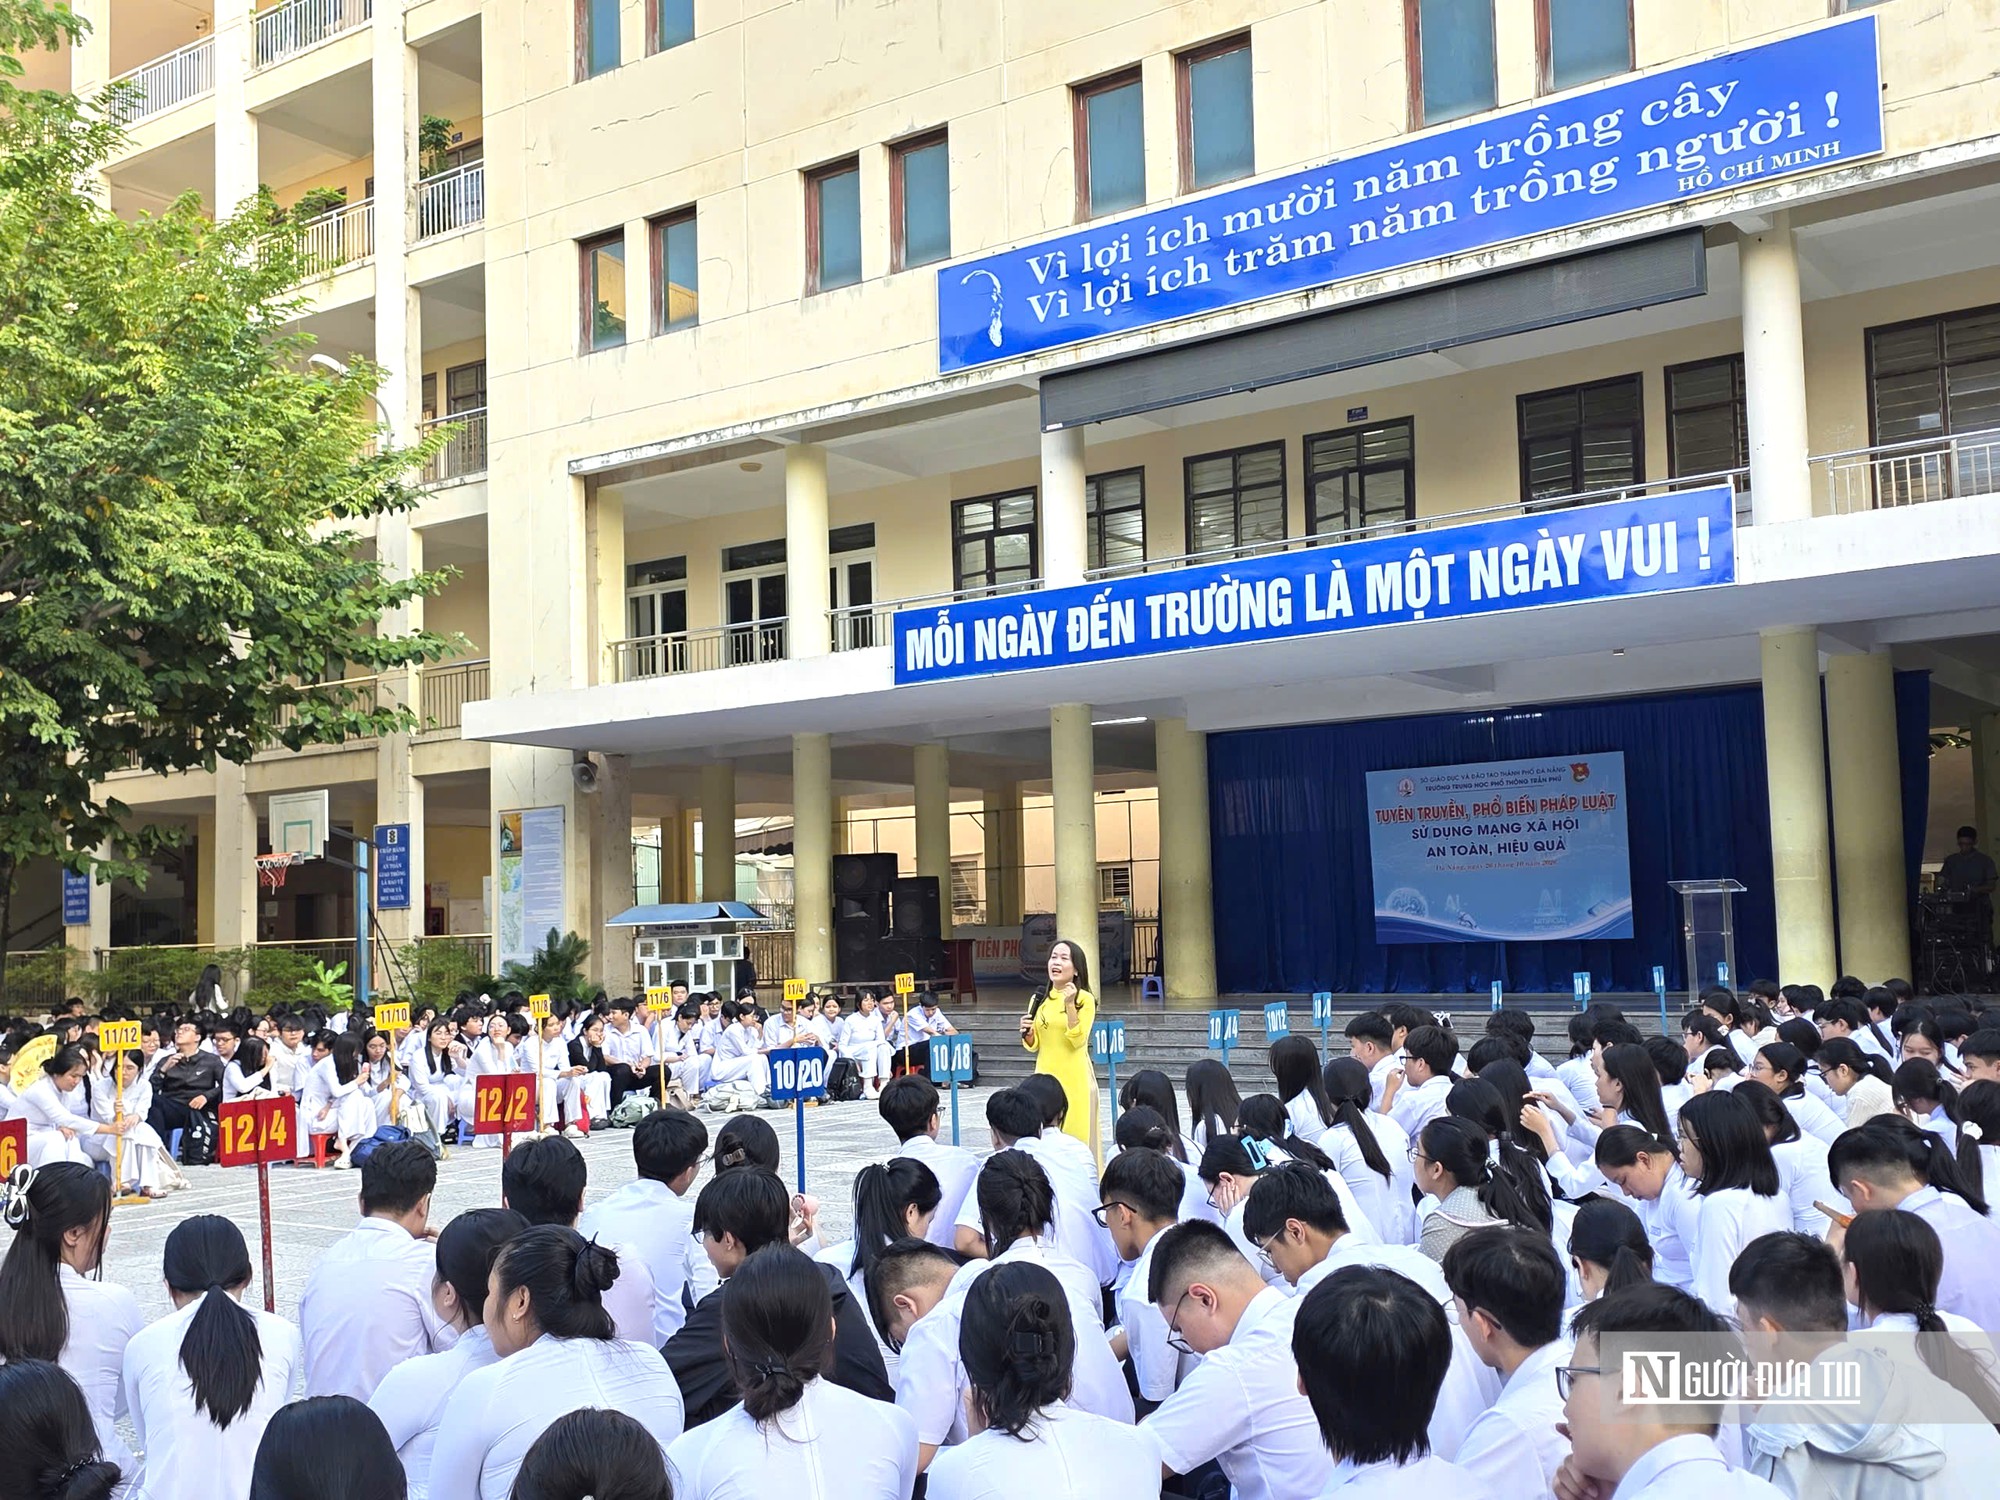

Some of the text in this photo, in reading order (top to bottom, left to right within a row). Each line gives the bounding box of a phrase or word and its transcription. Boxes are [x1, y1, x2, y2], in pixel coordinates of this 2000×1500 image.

[1677, 140, 1841, 192] HỒ CHÍ MINH
[1026, 80, 1739, 285] Vì lợi ích mười năm trồng cây
[1026, 90, 1840, 323] Vì lợi ích trăm năm trồng người !
[905, 516, 1711, 671] MỖI NGÀY ĐẾN TRƯỜNG LÀ MỘT NGÀY VUI !
[1375, 793, 1617, 824] TUYÊN TRUYỀN, PHỔ BIẾN PHÁP LUẬT
[1411, 816, 1580, 840] SỬ DỤNG MẠNG XÃ HỘI
[1426, 835, 1566, 858] AN TOÀN, HIỆU QUẢ
[976, 936, 1000, 958] TIÊN
[786, 983, 804, 996] 11/4
[898, 976, 912, 988] 11/2
[532, 1000, 548, 1013] 11/8
[649, 992, 669, 1005] 11/6
[380, 1007, 407, 1024] 11/10
[1210, 1015, 1238, 1040] 10/14
[1266, 1009, 1287, 1032] 10/12
[103, 1026, 138, 1045] 11/12
[1095, 1028, 1125, 1054] 10/16
[933, 1042, 970, 1072] 10/18
[773, 1058, 823, 1091] 10/20
[477, 1086, 528, 1123] 12/2
[220, 1109, 287, 1154] 12/4
